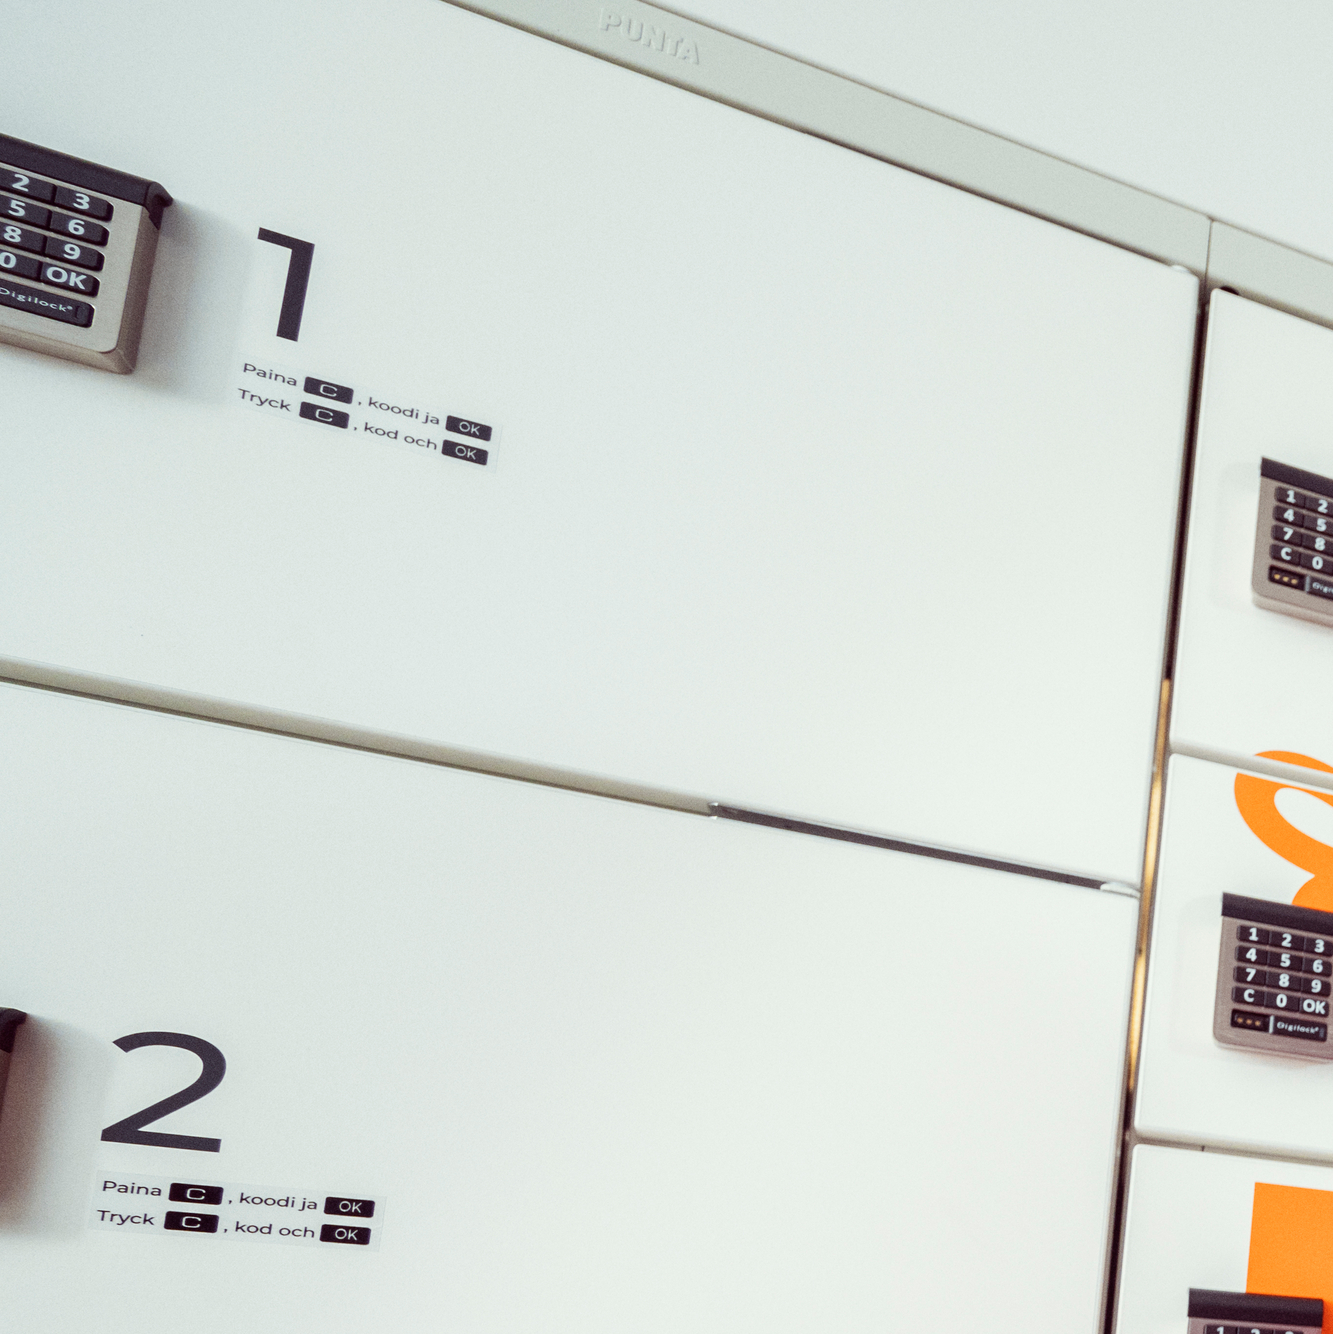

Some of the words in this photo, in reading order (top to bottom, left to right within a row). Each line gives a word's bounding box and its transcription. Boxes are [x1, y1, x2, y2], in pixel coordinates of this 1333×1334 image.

[600, 7, 699, 65] PUNTA
[12, 174, 30, 192] 2
[73, 193, 90, 210] 3
[8, 200, 26, 217] 5
[68, 220, 85, 236] 6
[3, 226, 22, 243] 8
[63, 244, 81, 260] 9
[0, 252, 17, 269] 0
[46, 267, 87, 290] OK
[257, 227, 315, 342] 1
[243, 363, 298, 387] Paina
[368, 397, 419, 420] koodi
[422, 412, 440, 425] ja
[459, 421, 481, 436] OK
[238, 388, 291, 412] Tryck
[364, 423, 399, 440] kod
[404, 434, 438, 450] och
[455, 446, 477, 460] OK
[1287, 490, 1296, 504] 1
[1318, 500, 1328, 514] 2
[1284, 509, 1295, 522] 4
[1316, 518, 1327, 532] 5
[1283, 527, 1294, 540] 7
[1315, 537, 1326, 551] 8
[1281, 548, 1292, 561] C
[1312, 556, 1323, 570] 0
[1249, 928, 1259, 941] 1
[1282, 933, 1292, 948] 2
[1315, 939, 1325, 953] 3
[1246, 948, 1257, 962] 4
[1280, 953, 1291, 967] 5
[1313, 959, 1323, 973] 6
[1246, 968, 1257, 982] 7
[1279, 974, 1290, 988] 8
[1311, 979, 1322, 993] 9
[1244, 989, 1255, 1002] C
[1276, 994, 1287, 1008] 0
[1303, 999, 1326, 1015] OK
[101, 1031, 227, 1153] 2
[102, 1180, 162, 1196] Paina
[240, 1193, 296, 1208] koodi
[299, 1197, 318, 1211] ja
[339, 1201, 362, 1214] OK
[97, 1209, 155, 1226] Tryck
[235, 1222, 272, 1235] kod
[279, 1225, 315, 1238] och
[335, 1229, 358, 1241] OK
